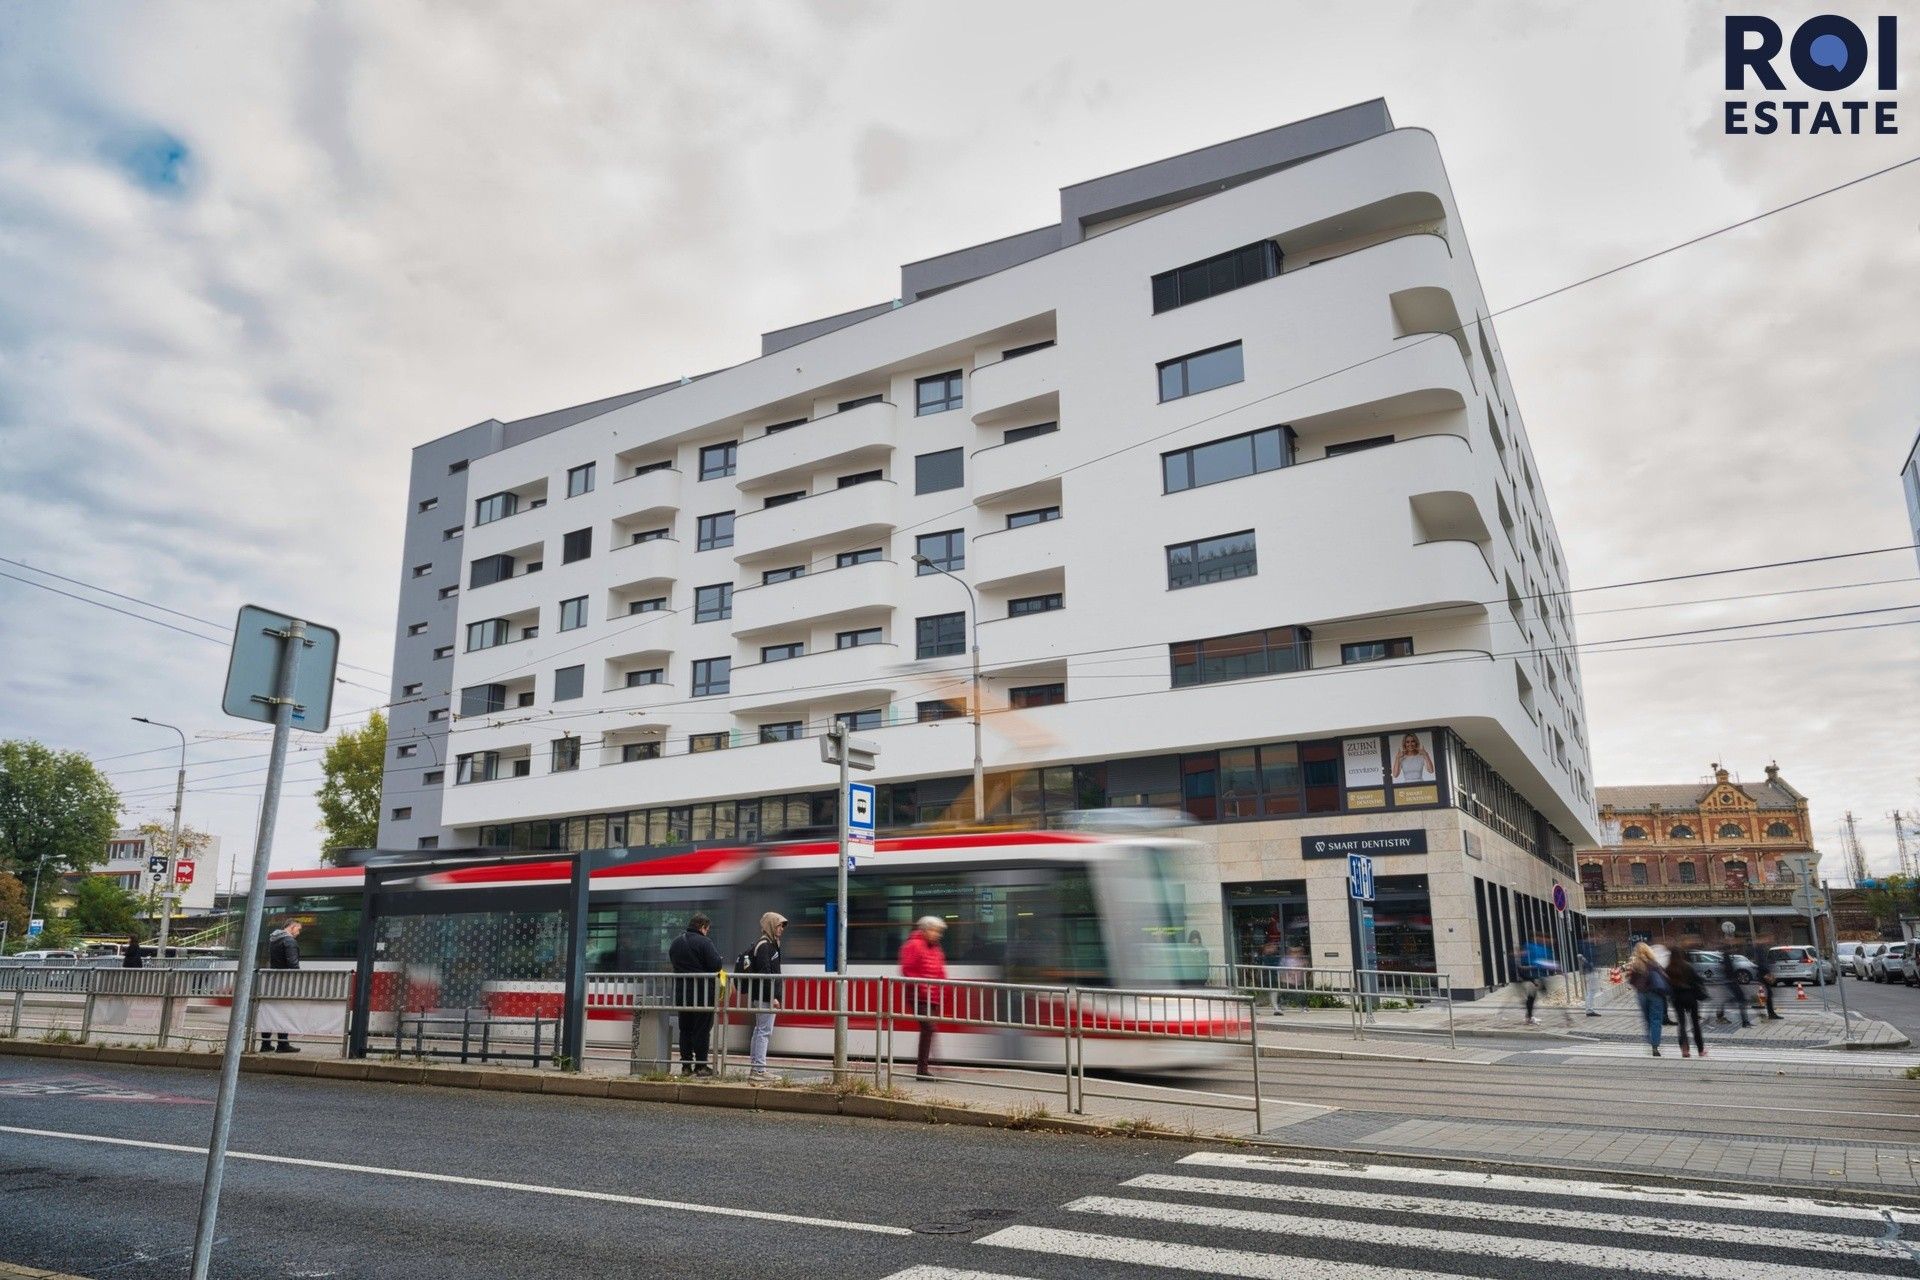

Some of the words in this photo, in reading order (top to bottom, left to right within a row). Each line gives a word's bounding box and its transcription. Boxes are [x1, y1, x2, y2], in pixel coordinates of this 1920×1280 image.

[1347, 740, 1377, 751] ZUBNÍ
[1328, 841, 1358, 850] SMART
[1361, 838, 1411, 849] DENTISTRY
